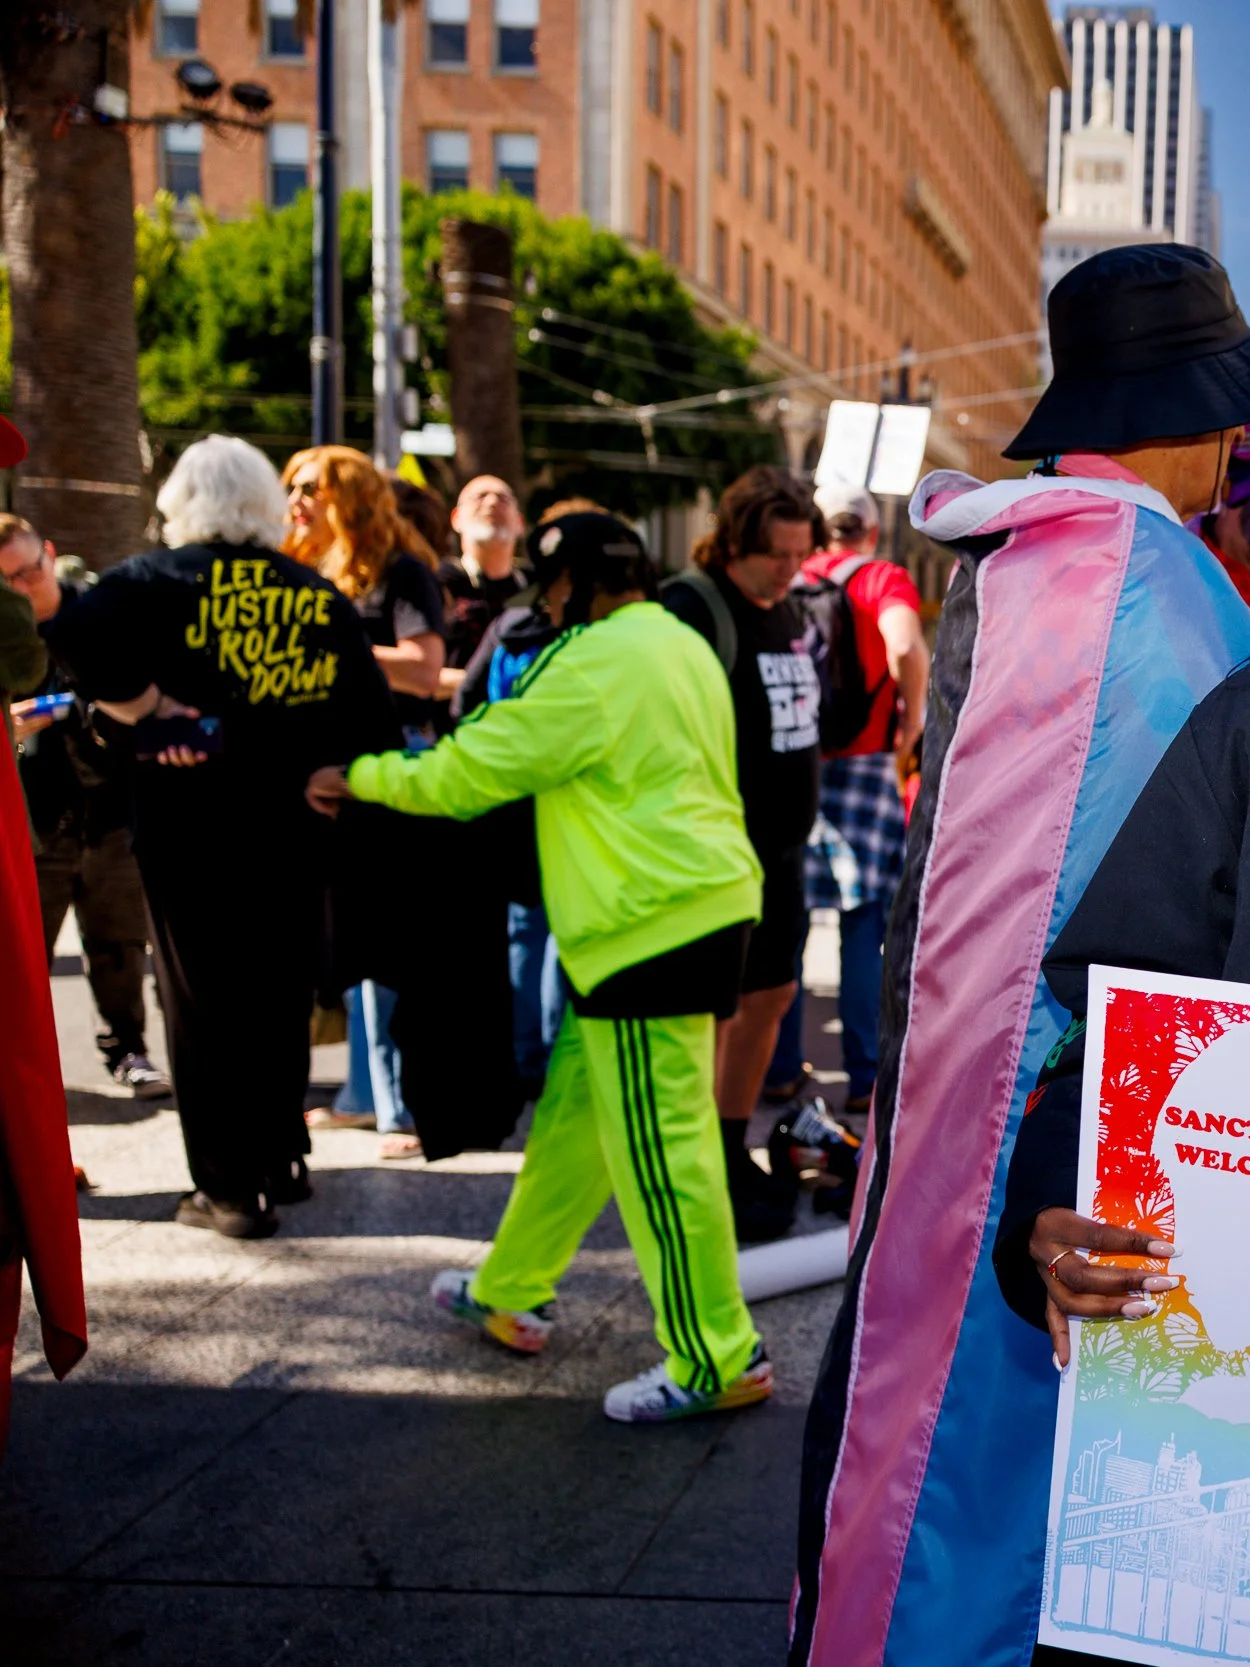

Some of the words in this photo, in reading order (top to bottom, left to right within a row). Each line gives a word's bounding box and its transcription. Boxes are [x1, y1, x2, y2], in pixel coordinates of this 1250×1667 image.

[210, 557, 271, 597] LET
[185, 586, 336, 649] JUSTICE
[217, 622, 306, 681] ROLL
[247, 652, 339, 705] DOWN
